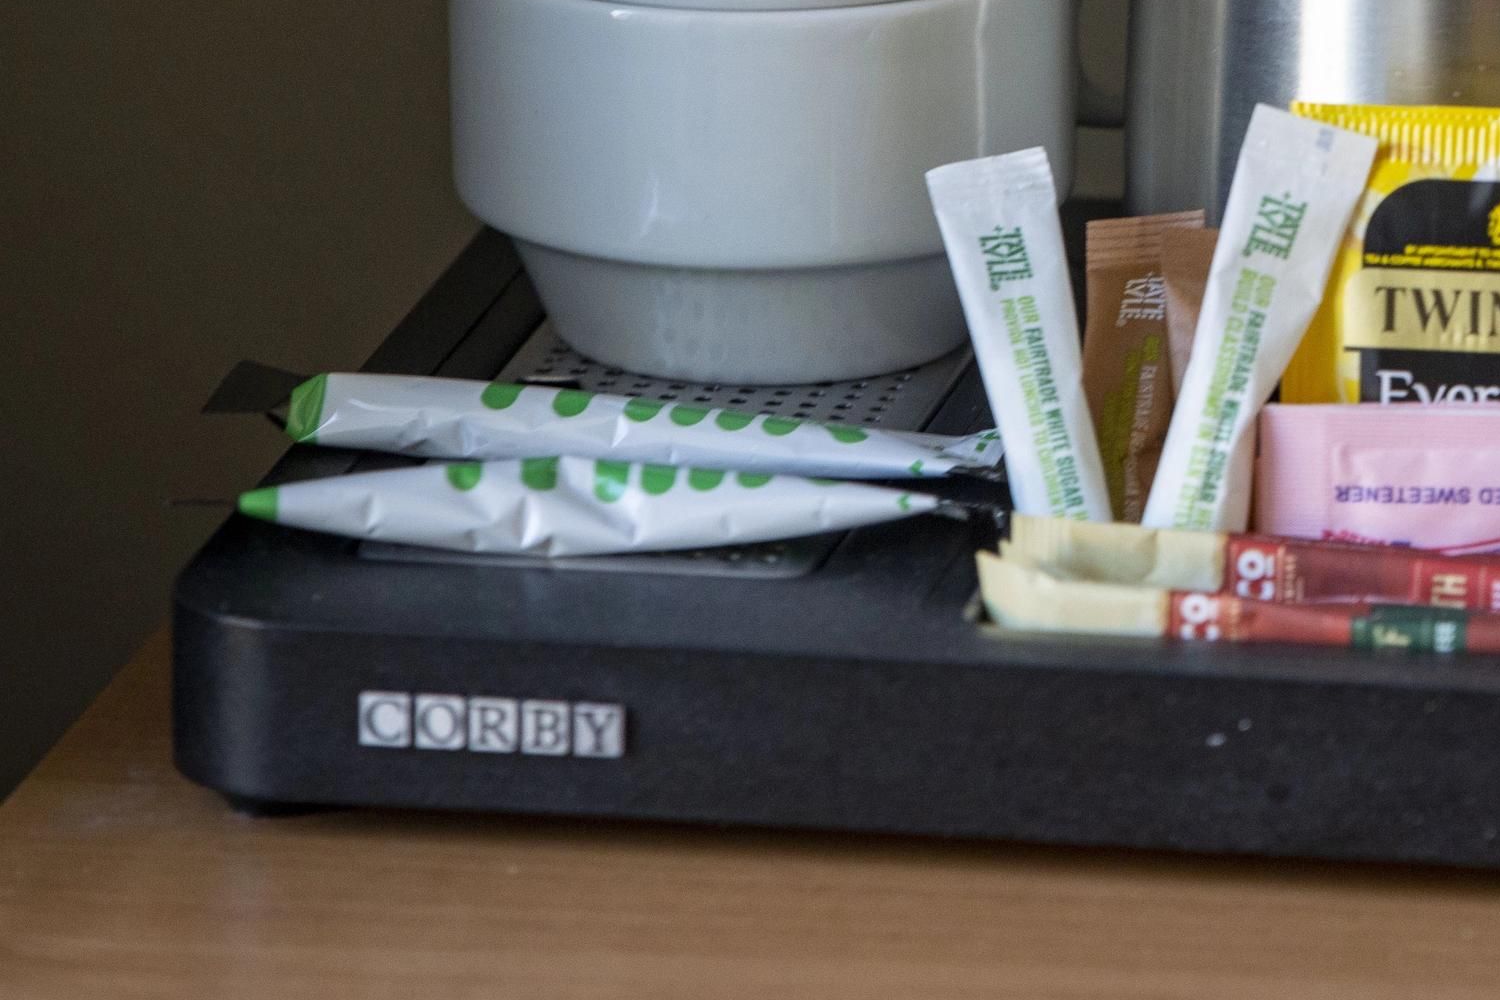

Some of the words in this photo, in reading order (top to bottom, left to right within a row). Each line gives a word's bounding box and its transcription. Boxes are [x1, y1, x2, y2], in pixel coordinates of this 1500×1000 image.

[1246, 194, 1284, 253] LYLE
[1270, 202, 1308, 260] TATE
[1017, 295, 1040, 324] OUR
[1024, 326, 1060, 404] FAIRTRADE
[1227, 310, 1267, 392] FAIRTRADE
[1045, 407, 1072, 452] WHITE
[1056, 455, 1085, 509] SUGAR
[1333, 484, 1471, 506] SWEETENER
[362, 697, 620, 755] CORBY
